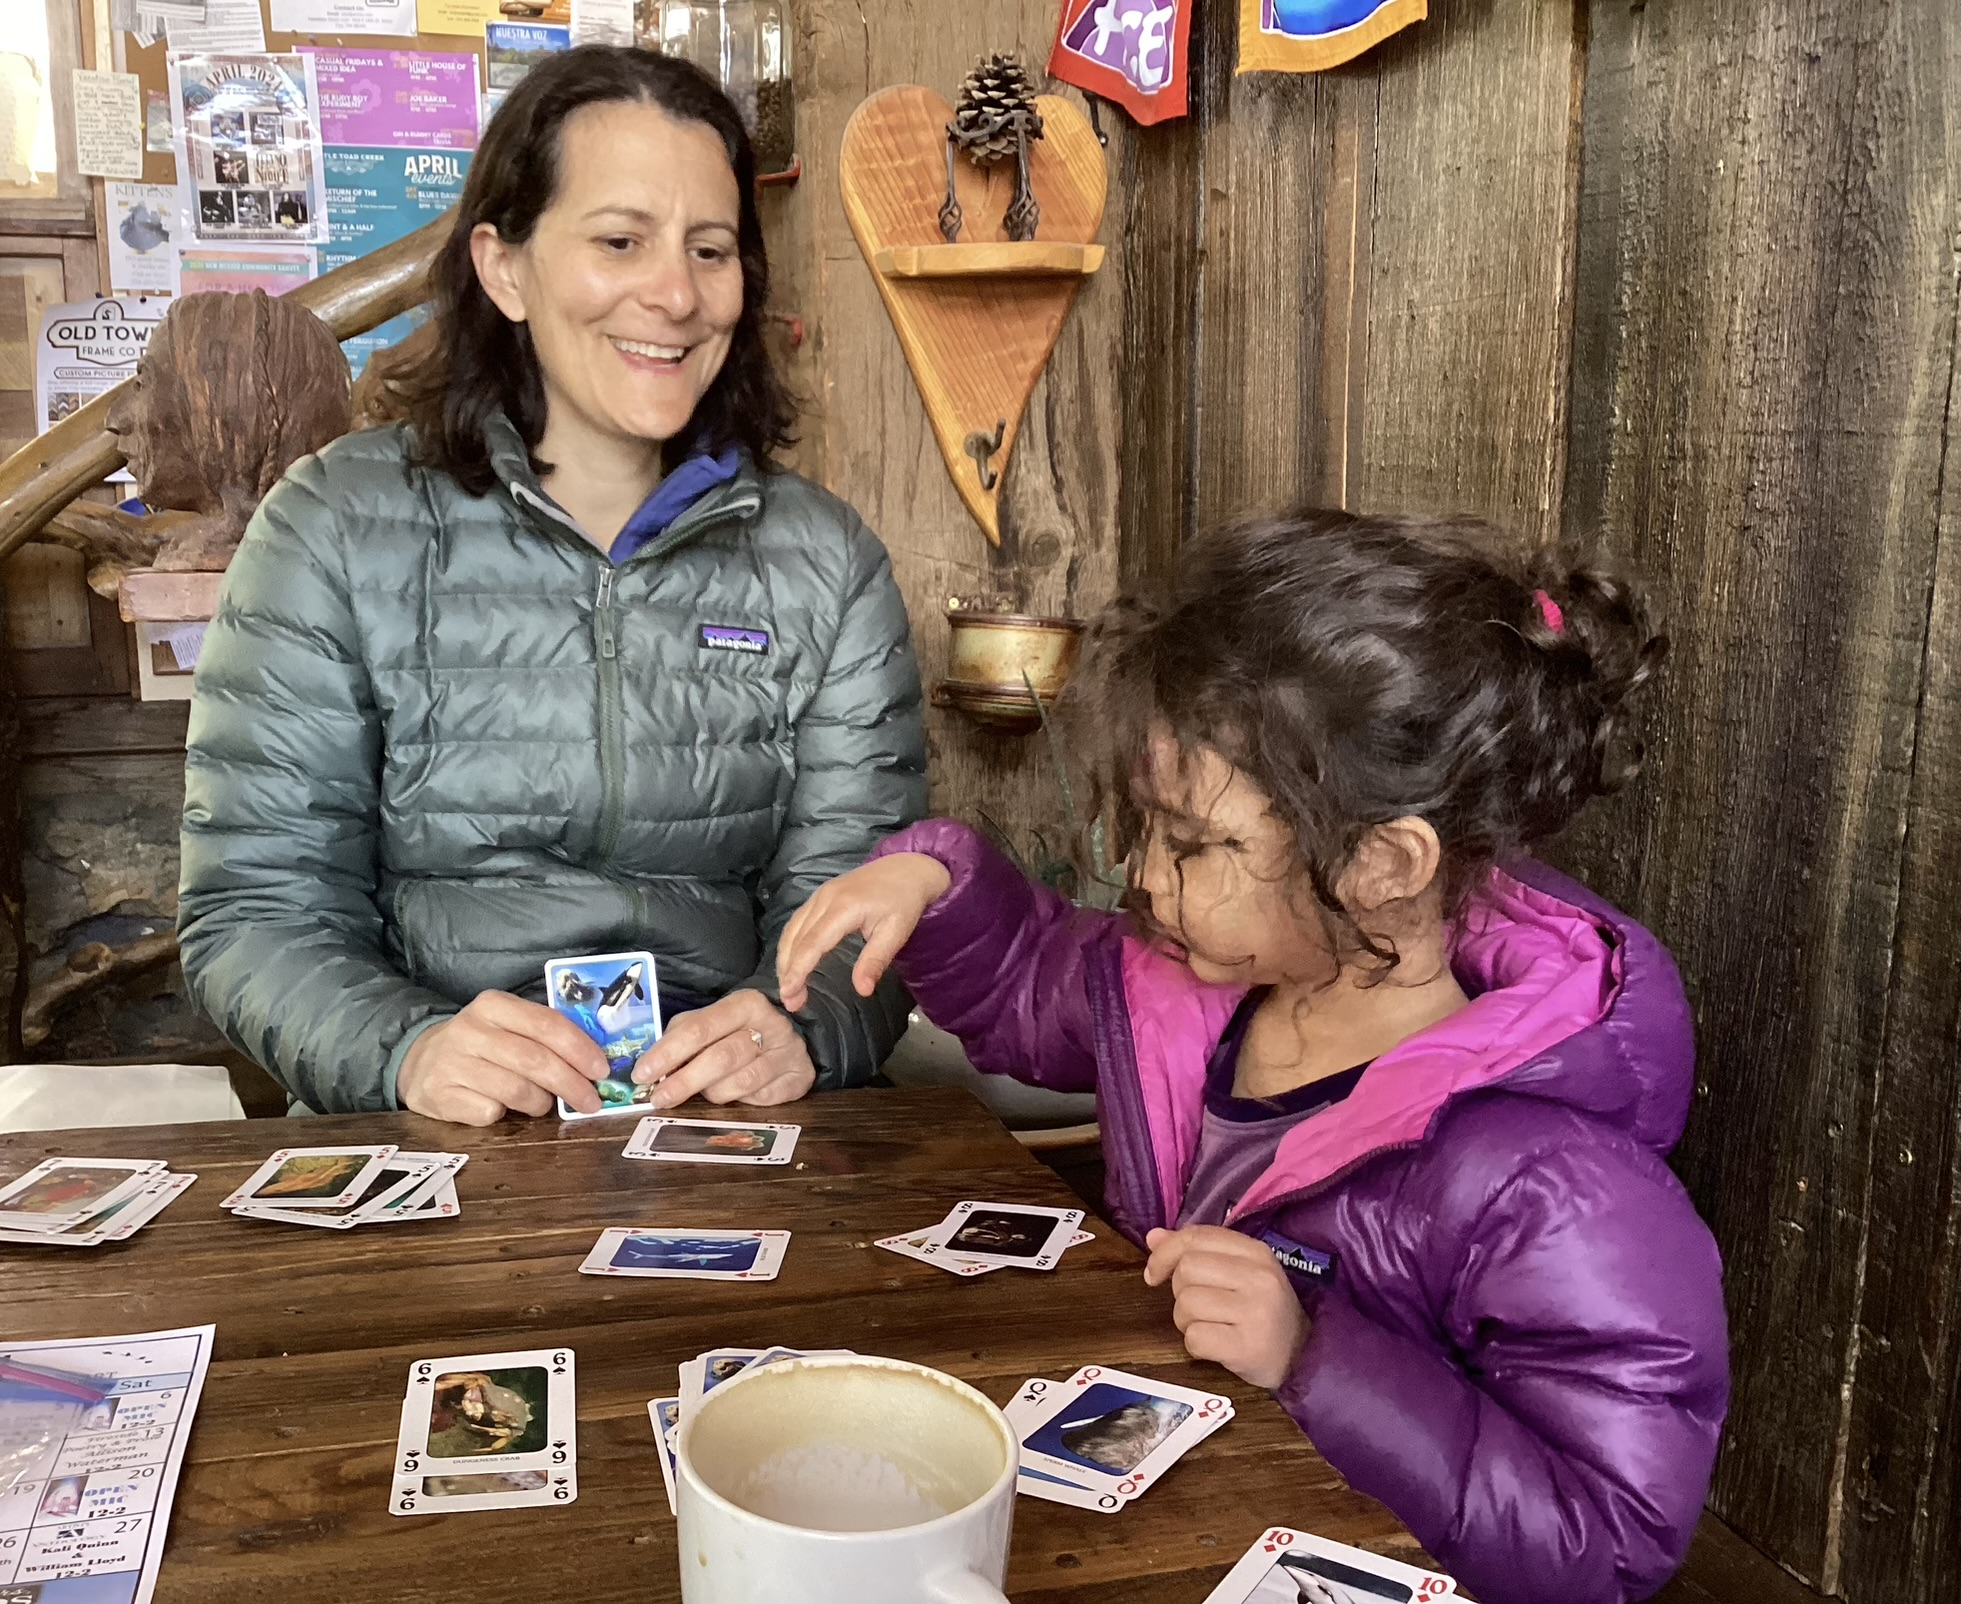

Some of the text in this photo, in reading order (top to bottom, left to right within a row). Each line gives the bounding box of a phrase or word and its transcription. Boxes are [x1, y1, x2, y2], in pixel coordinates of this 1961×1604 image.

[496, 27, 548, 41] NUESTRA VOZ
[346, 58, 376, 66] FRIDAYS
[409, 61, 430, 69] LITTLE
[432, 62, 456, 70] HOUSE
[206, 64, 245, 87] APRIL
[321, 100, 362, 108] XPERIMENT
[404, 154, 462, 178] APRIL
[411, 172, 456, 186] events
[116, 184, 173, 198] KITTENS
[59, 326, 154, 341] OLD TOW
[82, 346, 114, 356] FRAME
[708, 638, 762, 651] patagonia
[450, 1156, 462, 1164] 5
[1272, 1246, 1321, 1274] agonia
[553, 1352, 566, 1365] 6
[418, 1363, 432, 1375] 6
[1084, 1368, 1101, 1381] Q
[119, 1380, 152, 1390] Sat
[1030, 1382, 1047, 1395] Q
[161, 1391, 172, 1399] 6
[118, 1403, 166, 1414] OPEN
[1204, 1399, 1222, 1412] Q
[121, 1420, 155, 1429] 12-2
[145, 1428, 164, 1437] 13
[67, 1452, 148, 1468] Waterman
[86, 1464, 121, 1473] 12-2
[128, 1468, 154, 1480] 20
[14, 1484, 36, 1495] 19
[84, 1484, 138, 1497] OPEN
[1117, 1479, 1138, 1494] Q
[90, 1495, 128, 1506] MIC
[1099, 1493, 1117, 1508] Q
[88, 1507, 126, 1518] 12-2
[114, 1519, 142, 1533] 27
[1265, 1530, 1294, 1546] 10
[42, 1545, 71, 1554] Kali
[76, 1540, 118, 1551] Quinn
[26, 1556, 126, 1572] William Lloyd
[55, 1569, 91, 1579] 12-2
[1418, 1577, 1448, 1595] 10
